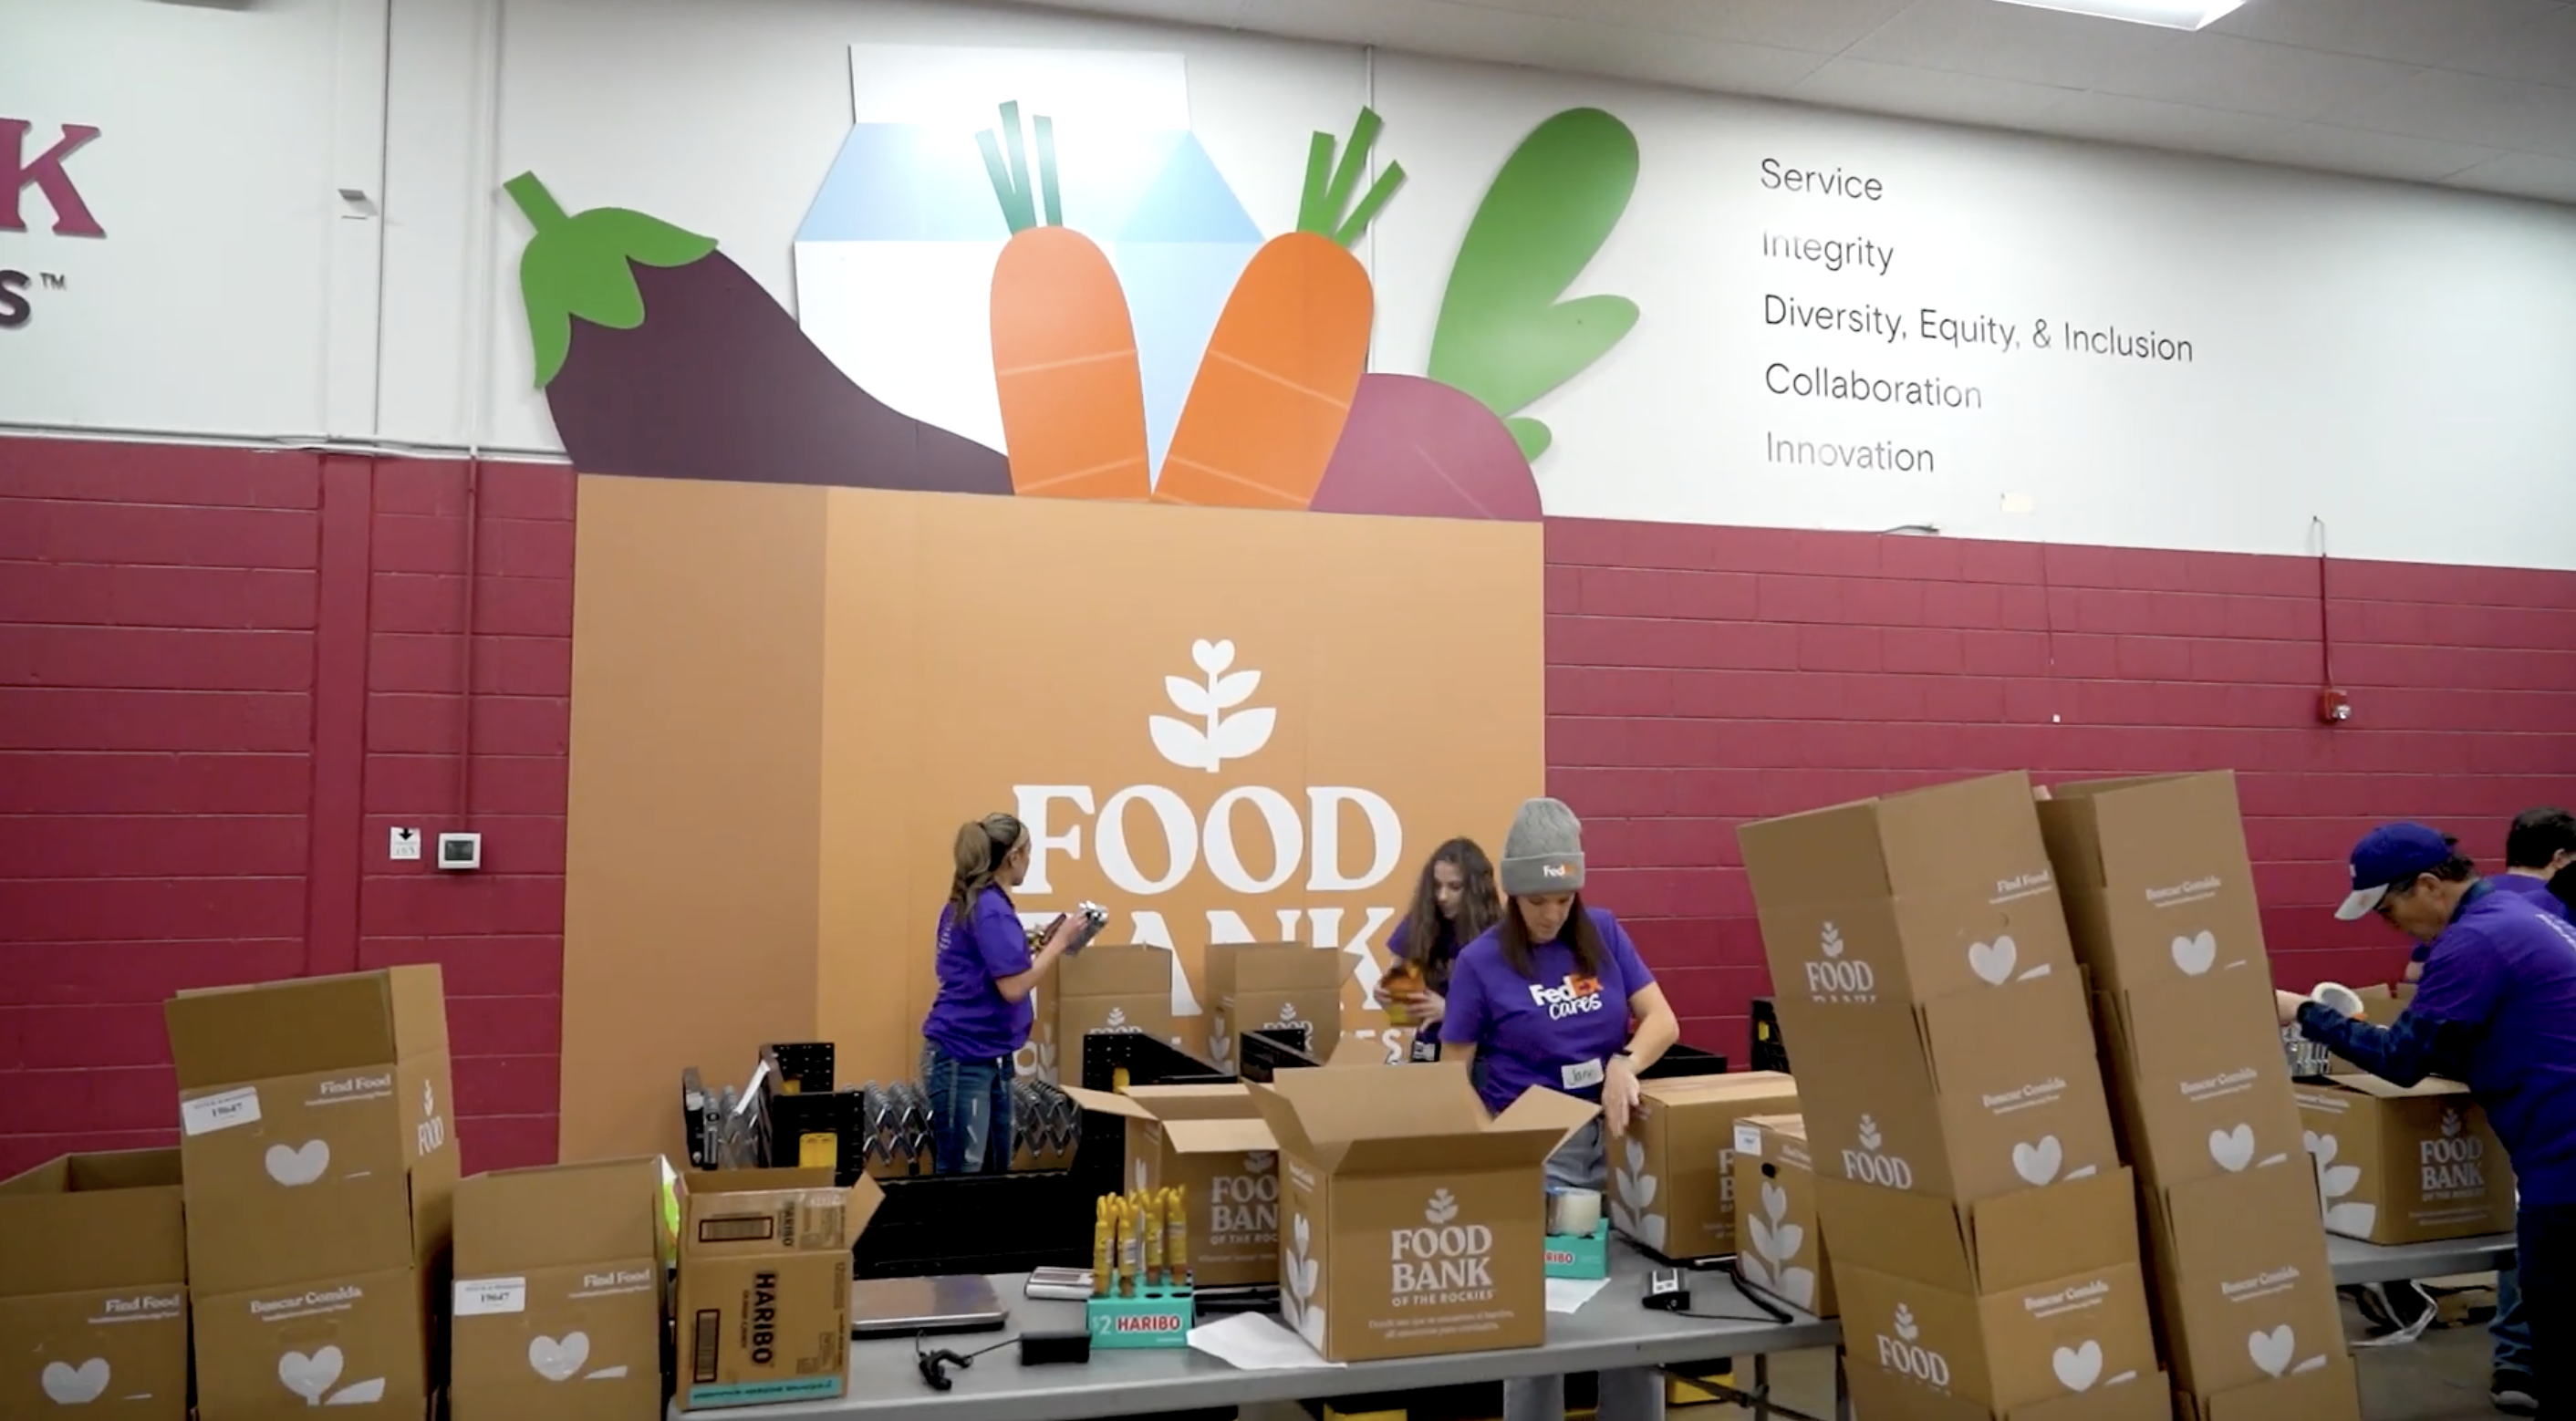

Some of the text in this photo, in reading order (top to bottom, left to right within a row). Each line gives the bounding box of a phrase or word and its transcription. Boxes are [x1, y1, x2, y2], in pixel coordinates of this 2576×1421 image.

[1761, 157, 1884, 201] Service
[1762, 229, 1894, 275] Integrity
[1764, 293, 2193, 363] Diversity, Equity, & Inclusion
[1765, 363, 1983, 409] Collaboration
[1766, 431, 1935, 472] Innovation
[1012, 784, 1403, 895] FOOD
[1529, 972, 1604, 1006] FedEx
[1805, 959, 1875, 992] FOOD
[1549, 993, 1603, 1020] cares
[320, 1074, 391, 1094] Find Food
[2420, 1136, 2484, 1165] FOOD
[1842, 1149, 1913, 1189] FOOD
[2421, 1161, 2486, 1190] BANK
[1210, 1175, 1278, 1204] FOO
[1210, 1204, 1278, 1232] BAN
[1391, 1224, 1493, 1260] FOOD
[1545, 1251, 1574, 1264] RIBO
[1391, 1257, 1493, 1294] BANK
[1391, 1290, 1494, 1308] OF THE ROCKIES
[751, 1273, 776, 1364] HARIBO
[1117, 1313, 1182, 1333] HARIBO
[1876, 1333, 1950, 1386] FOOD
